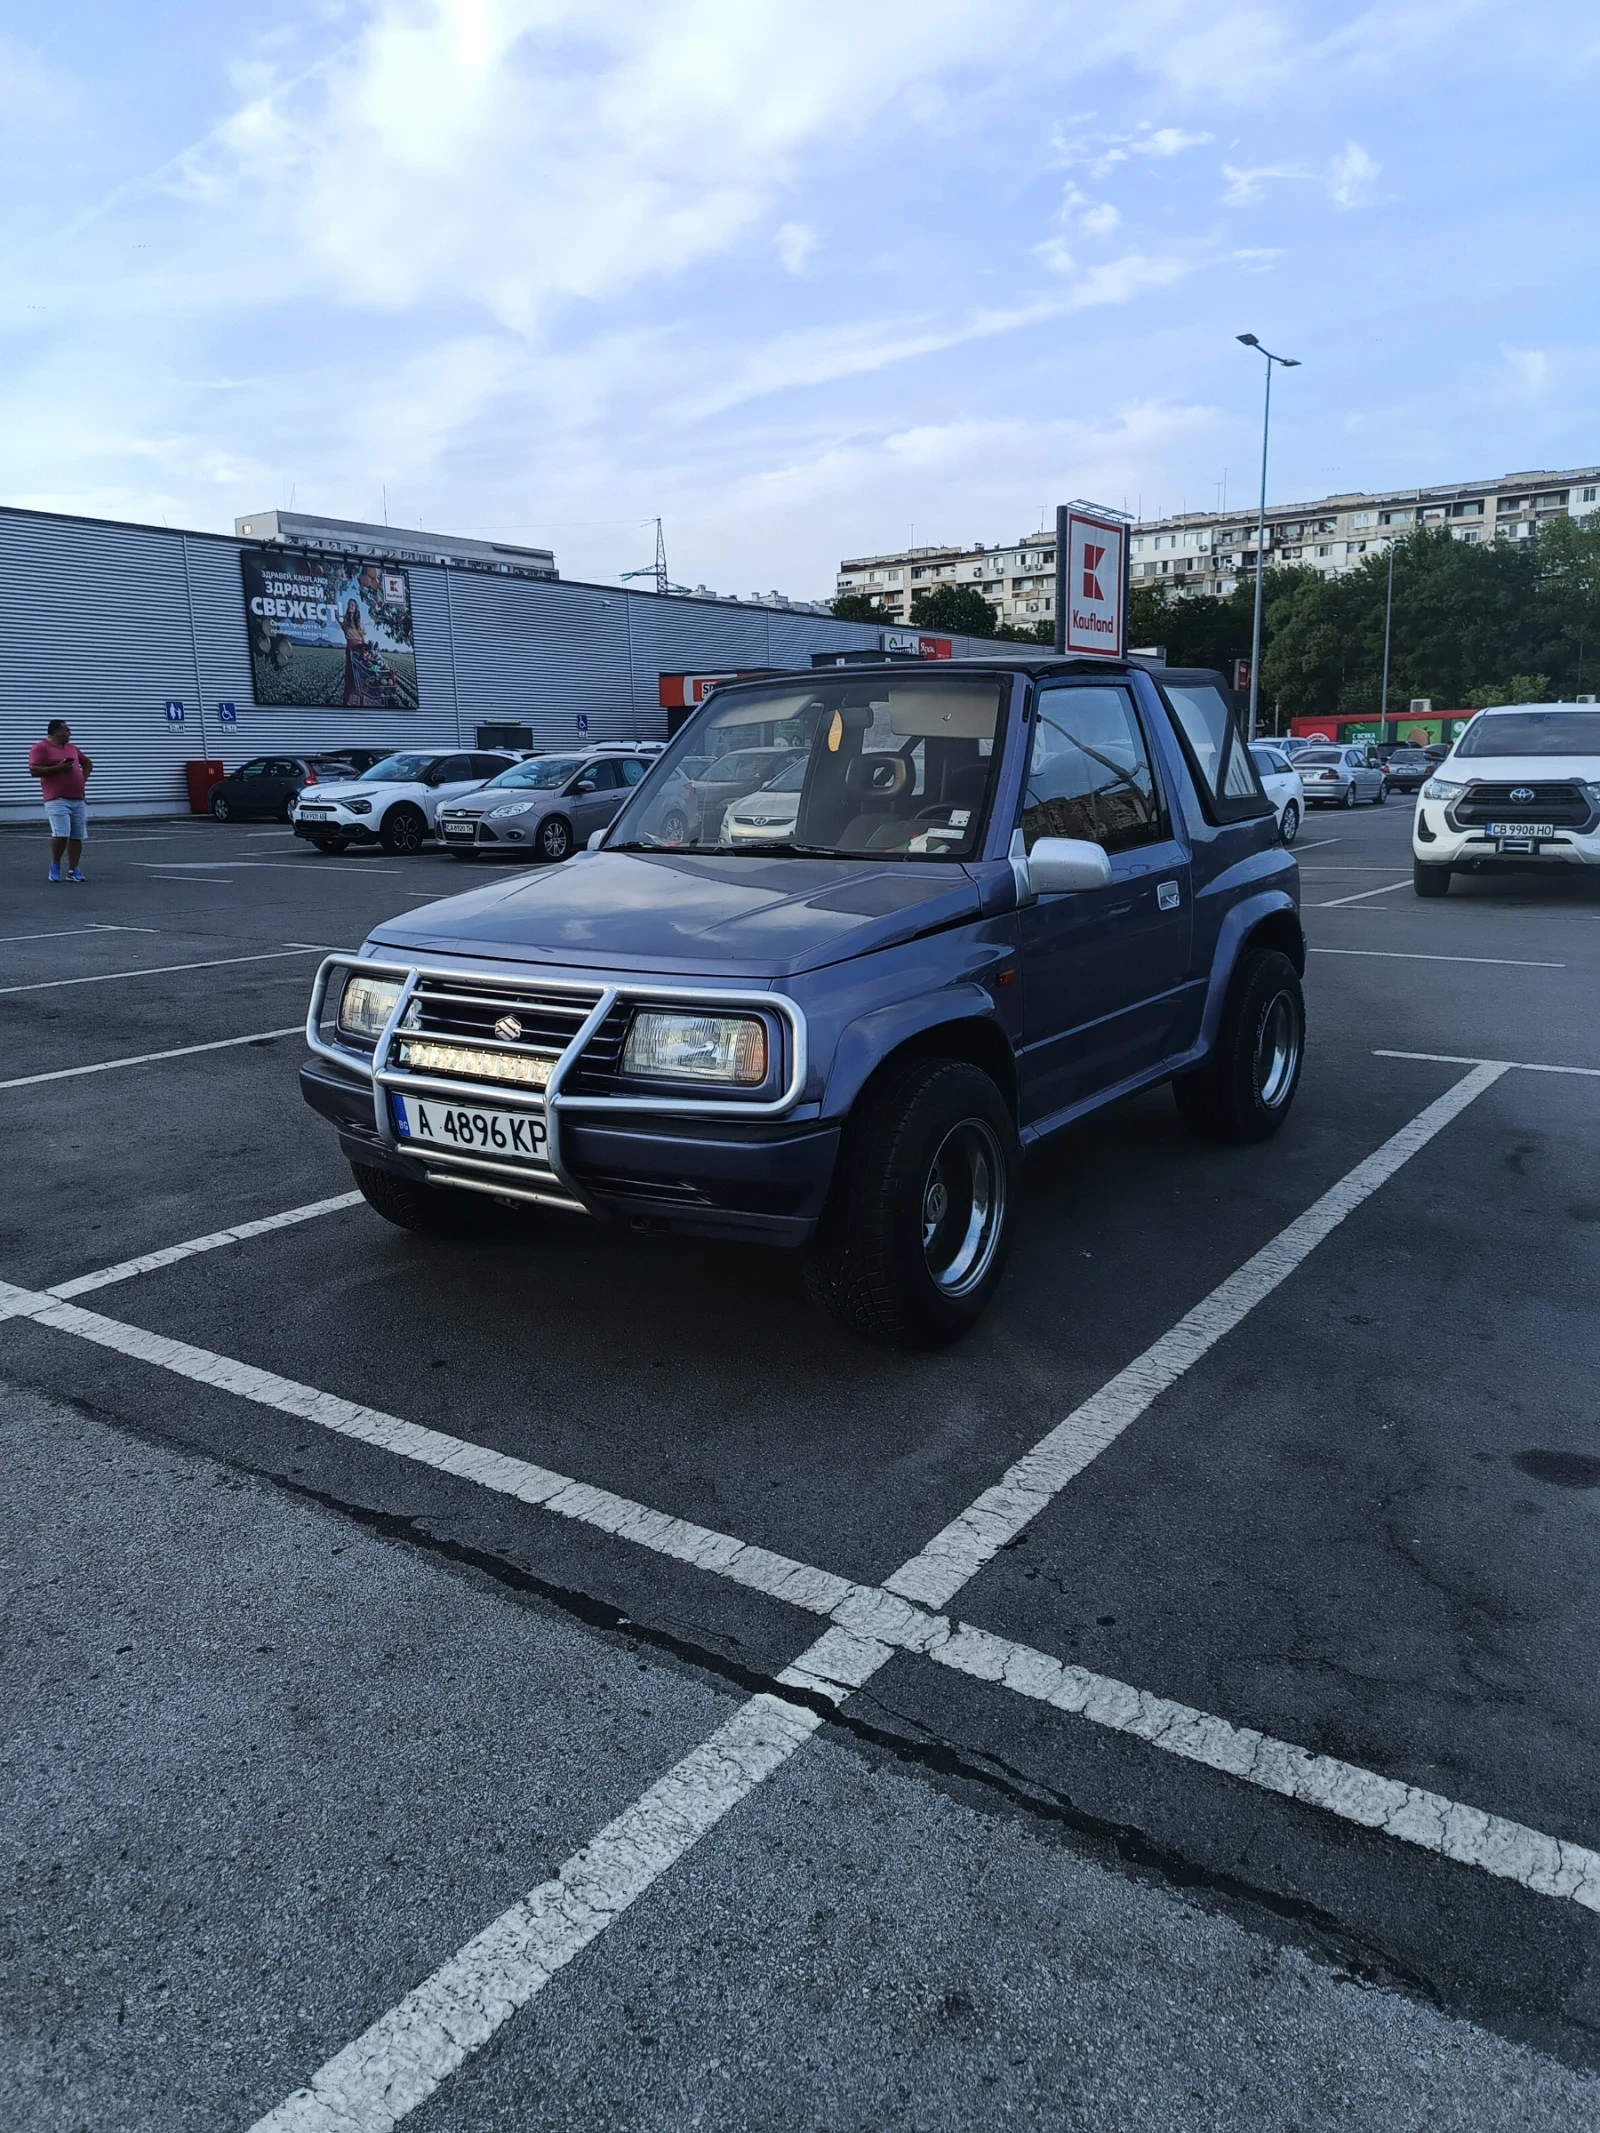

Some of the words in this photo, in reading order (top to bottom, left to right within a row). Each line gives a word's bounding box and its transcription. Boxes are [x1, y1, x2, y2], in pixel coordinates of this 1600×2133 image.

[261, 570, 293, 581] ЗДРАВЕЙ,
[293, 574, 328, 585] KAUFLAND!
[265, 581, 327, 601] ЗДРАВЕЙ,
[251, 597, 344, 622] СВЕЖЕСТ!
[1073, 609, 1114, 634] Kaufland
[1493, 825, 1506, 834] CB
[1509, 825, 1535, 835] 9908
[1537, 826, 1551, 835] HO
[399, 1120, 409, 1130] BG
[418, 1104, 434, 1137] A
[444, 1110, 506, 1148] 4896
[509, 1118, 547, 1153] KP
